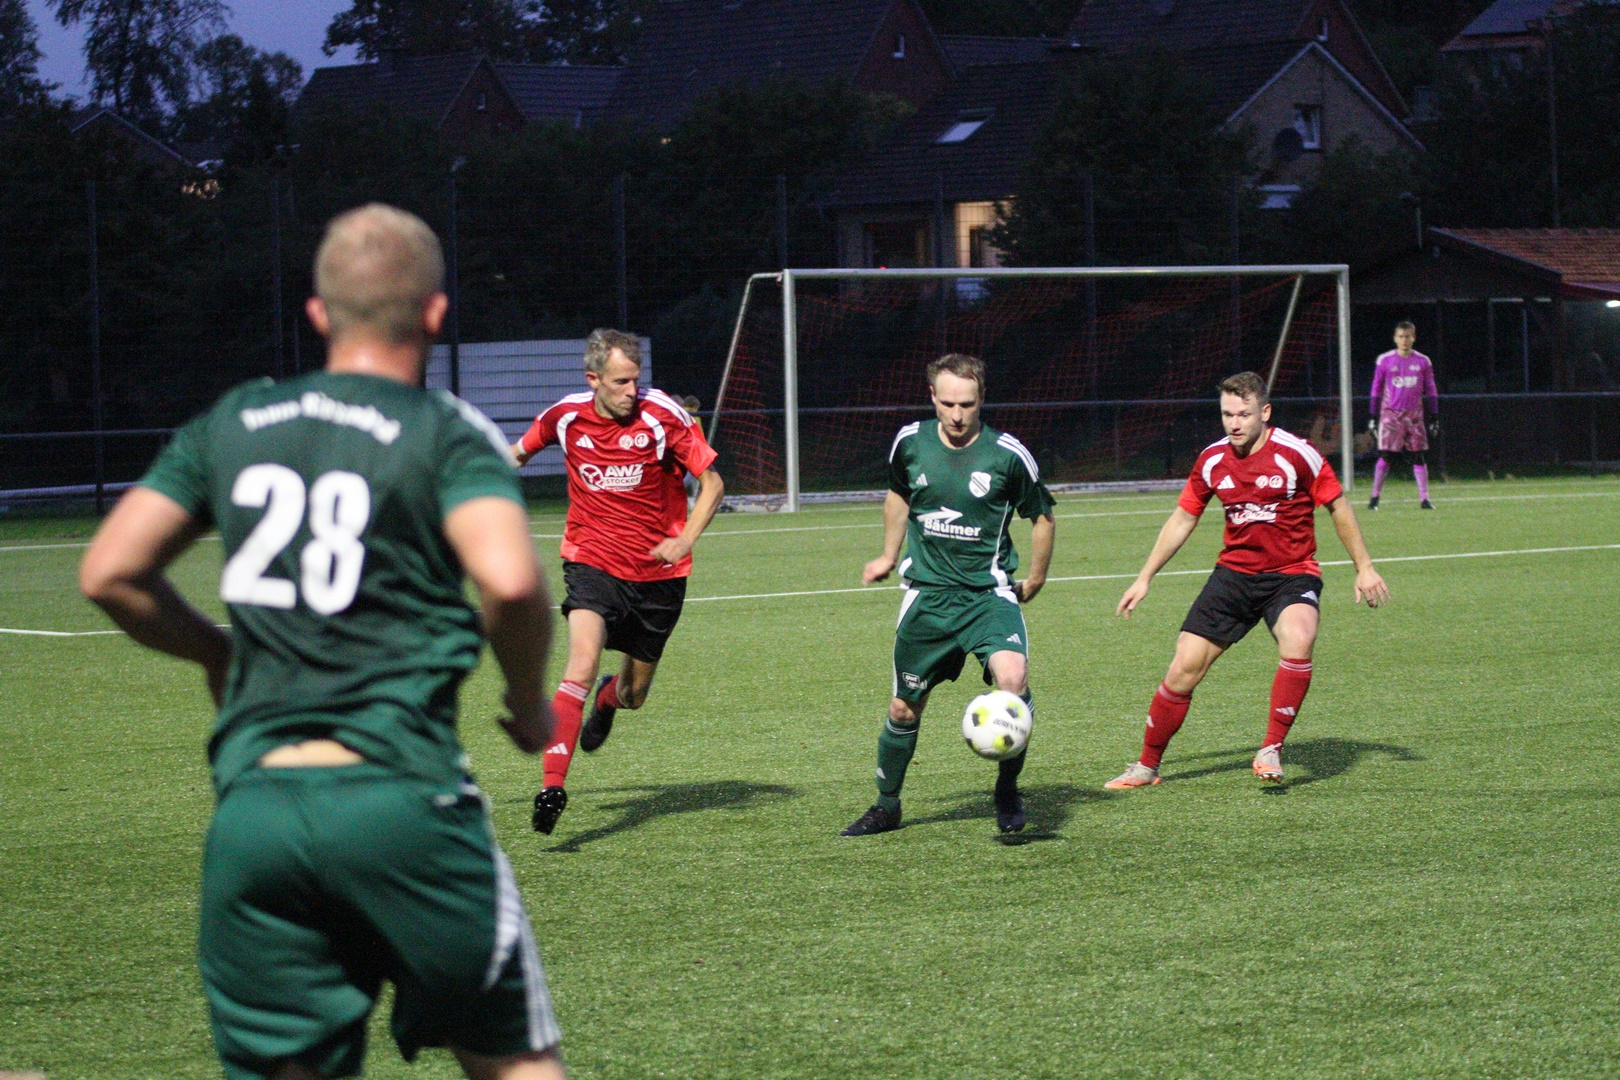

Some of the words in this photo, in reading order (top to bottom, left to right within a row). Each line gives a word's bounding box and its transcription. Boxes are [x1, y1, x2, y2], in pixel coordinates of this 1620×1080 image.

[605, 463, 645, 477] AWZ
[924, 517, 982, 537] Bäumer
[220, 462, 371, 616] 28
